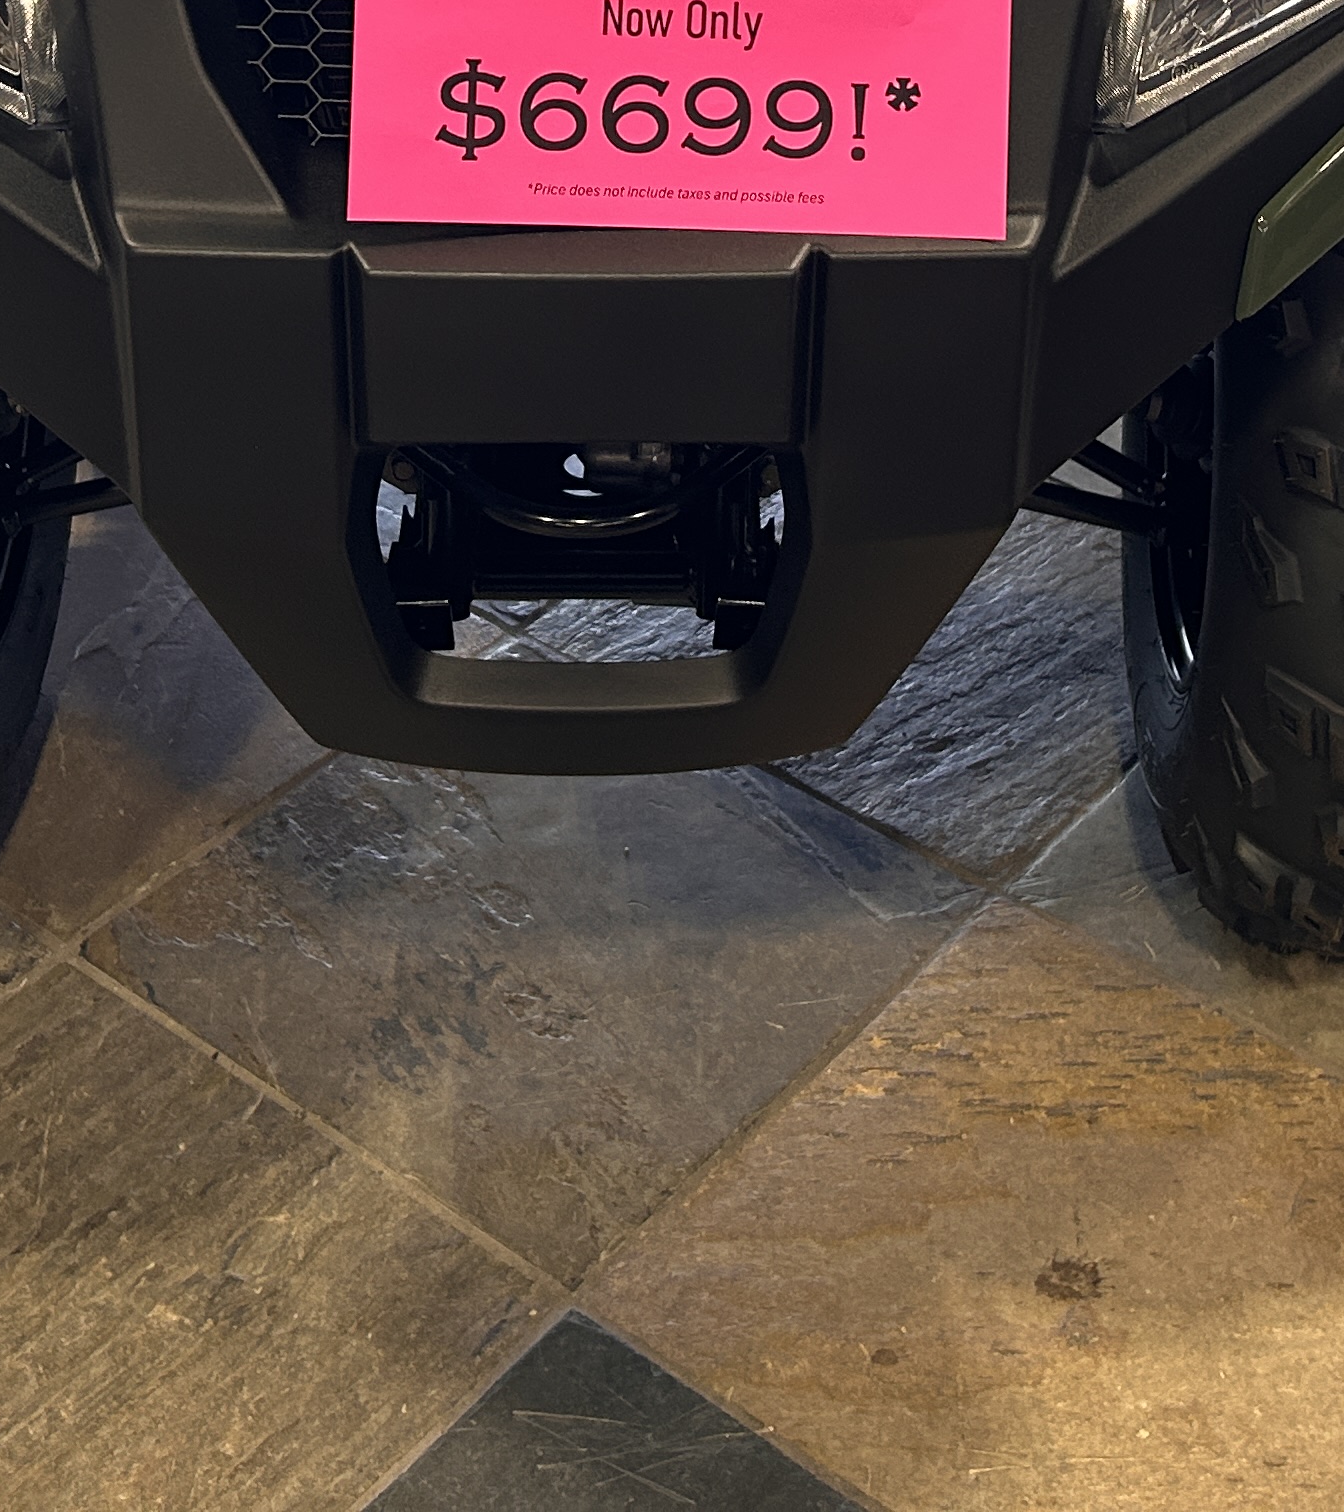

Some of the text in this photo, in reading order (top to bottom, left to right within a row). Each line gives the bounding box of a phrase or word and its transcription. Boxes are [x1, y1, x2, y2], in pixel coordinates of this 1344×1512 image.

[686, 0, 763, 51] Only
[569, 184, 601, 197] does
[602, 186, 625, 198] not
[627, 185, 675, 200] include
[677, 188, 712, 201] taxes
[714, 189, 739, 202] and
[740, 191, 795, 206] possible
[797, 191, 825, 205] fees
